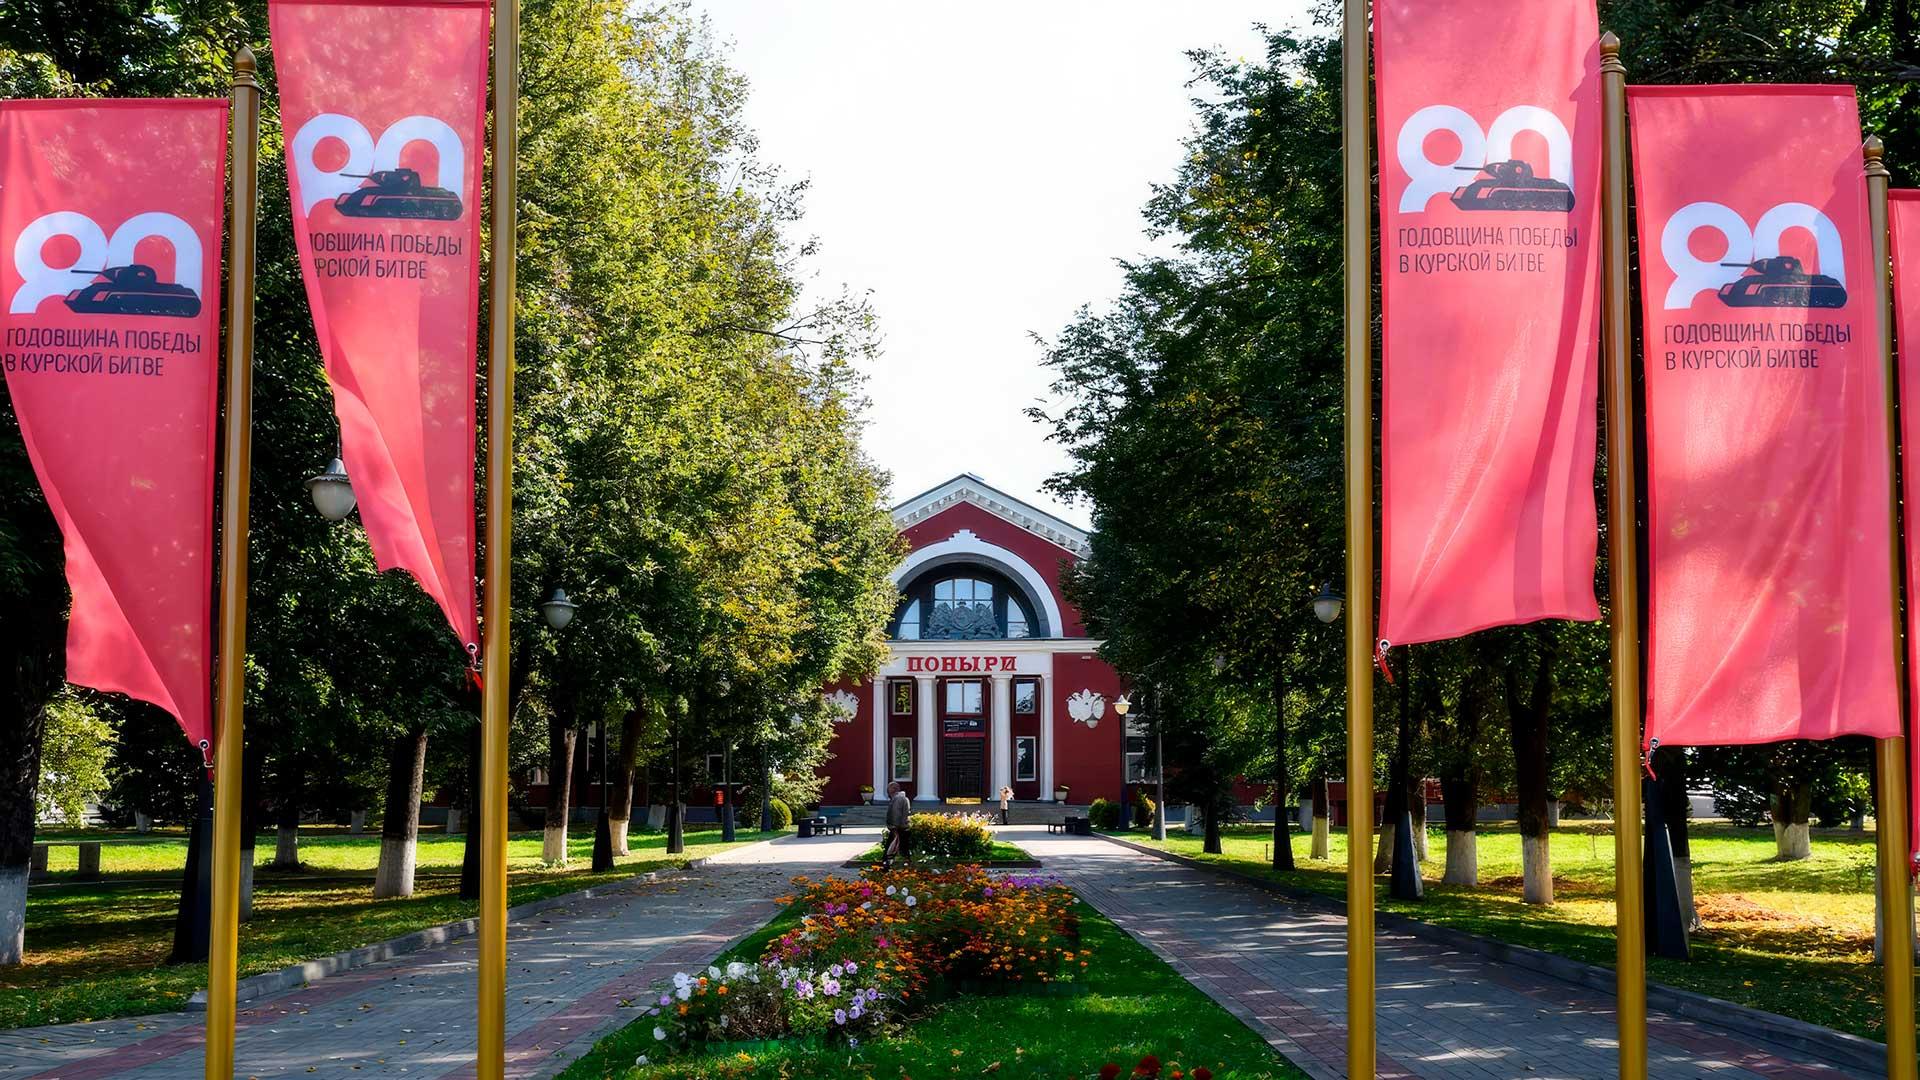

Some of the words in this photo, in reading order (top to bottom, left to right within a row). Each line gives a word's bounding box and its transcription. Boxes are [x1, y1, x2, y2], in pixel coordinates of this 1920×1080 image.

[309, 232, 385, 252] ОВЩИНА
[390, 234, 462, 257] ПОБЕДЫ
[1399, 227, 1504, 247] ГОДОВЩИНА
[1509, 227, 1578, 248] ПОБЕДЫ
[314, 255, 370, 278] РСКОЙ
[375, 259, 427, 279] БИТВЕ
[1400, 254, 1409, 273] В
[1415, 250, 1491, 274] КУРСКОЙ
[1496, 252, 1546, 273] БИТВЕ
[6, 327, 120, 349] ГОДОВЩИНА
[125, 330, 201, 353] ПОБЕДЫ
[1664, 323, 1775, 344] ГОДОВЩИНА
[1780, 323, 1851, 345] ПОБЕДЫ
[5, 353, 16, 372] В
[20, 352, 103, 374] КУРСКОЙ
[108, 355, 164, 377] БИТВЕ
[1666, 351, 1676, 371] В
[1682, 346, 1761, 369] КУРСКОЙ
[1766, 348, 1820, 369] БИТВЕ
[906, 656, 1017, 672] ПОНЫРИ
